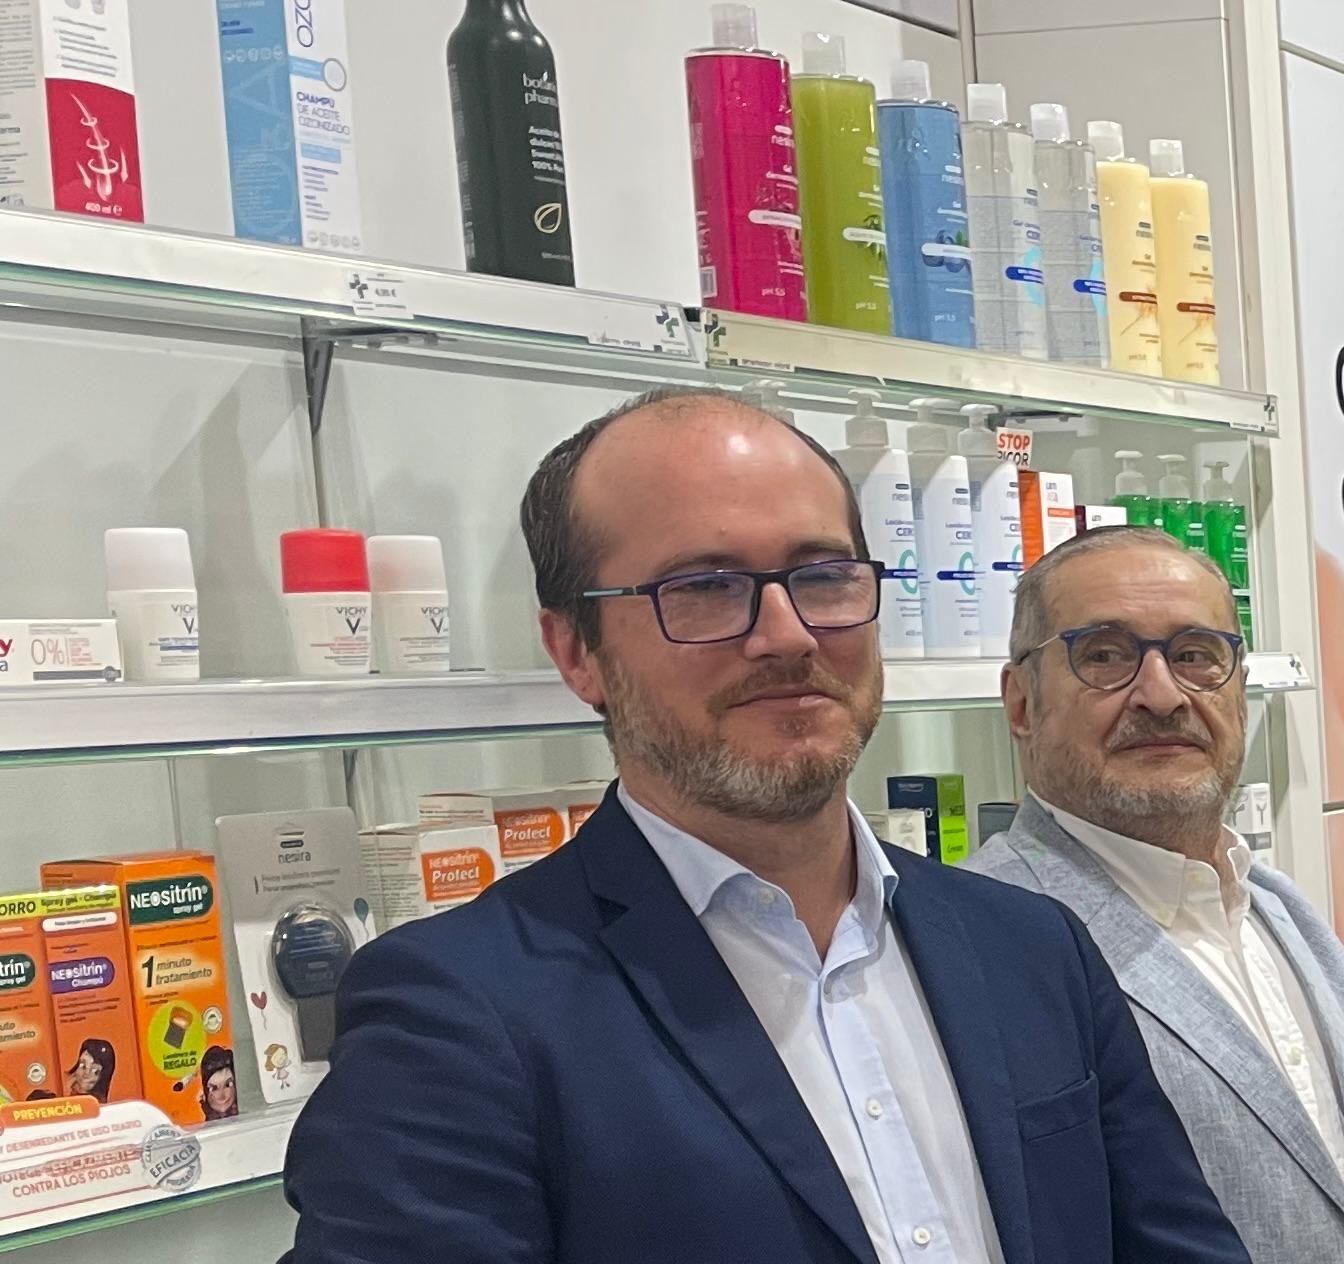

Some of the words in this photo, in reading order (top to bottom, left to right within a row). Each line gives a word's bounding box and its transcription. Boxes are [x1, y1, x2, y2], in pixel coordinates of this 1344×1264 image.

[998, 432, 1030, 449] STOP
[30, 638, 66, 666] 0%
[504, 825, 551, 841] Protect
[432, 867, 480, 883] Protect
[142, 955, 155, 988] 1
[157, 955, 192, 971] minuto
[156, 966, 213, 986] tratamiento
[163, 1057, 198, 1071] REGALO
[13, 1102, 83, 1122] PREVENCIÓN
[149, 1142, 197, 1178] EFICACIA
[12, 1178, 62, 1198] CONTRA
[63, 1173, 87, 1188] LOS
[88, 1164, 132, 1182] PIOJOS
